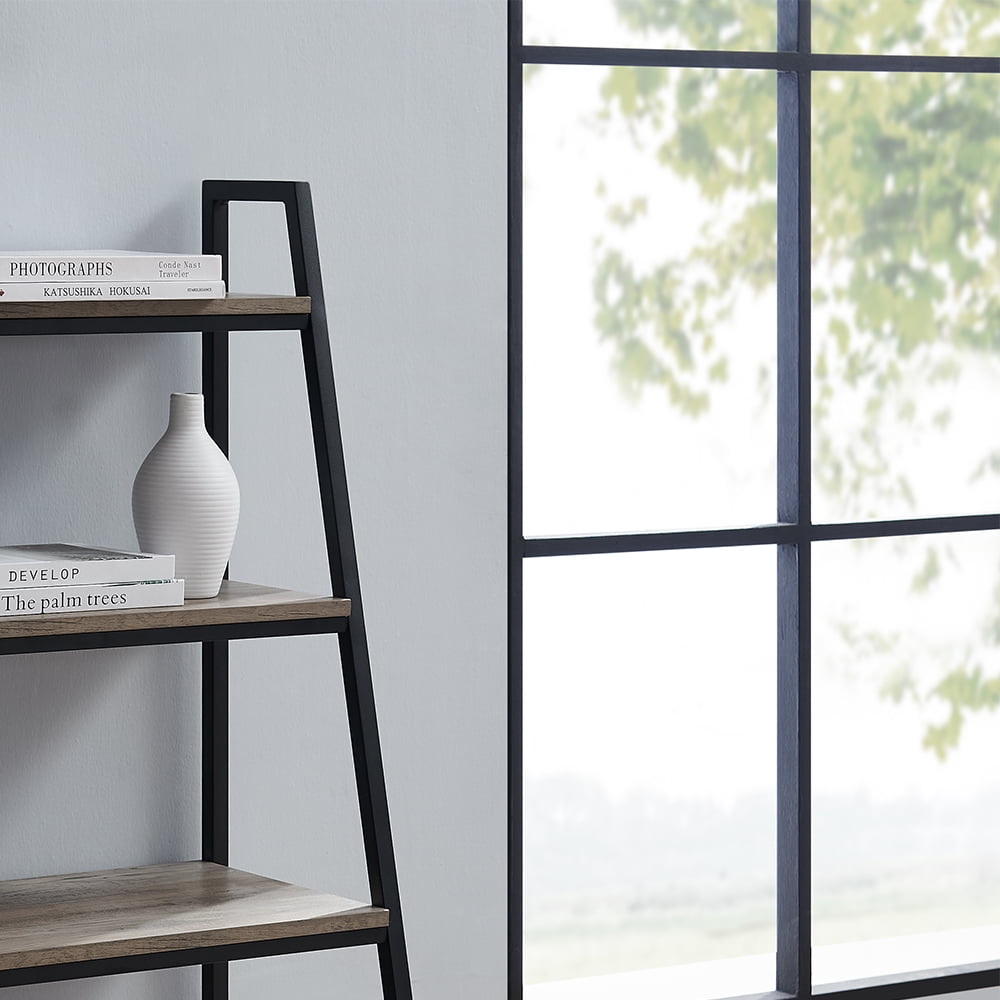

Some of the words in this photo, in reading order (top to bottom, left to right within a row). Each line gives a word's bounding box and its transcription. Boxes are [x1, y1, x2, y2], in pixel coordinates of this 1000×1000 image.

[10, 262, 113, 276] PHOTOGRAPHS
[158, 261, 181, 269] Conde
[183, 261, 201, 269] Nast
[158, 270, 190, 278] Traveler
[43, 287, 103, 297] KATSUSHIKA
[109, 286, 151, 297] HOKUSAI
[8, 568, 80, 582] DEVELOP
[1, 594, 36, 611] The
[41, 592, 82, 614] palm
[87, 593, 127, 606] trees
